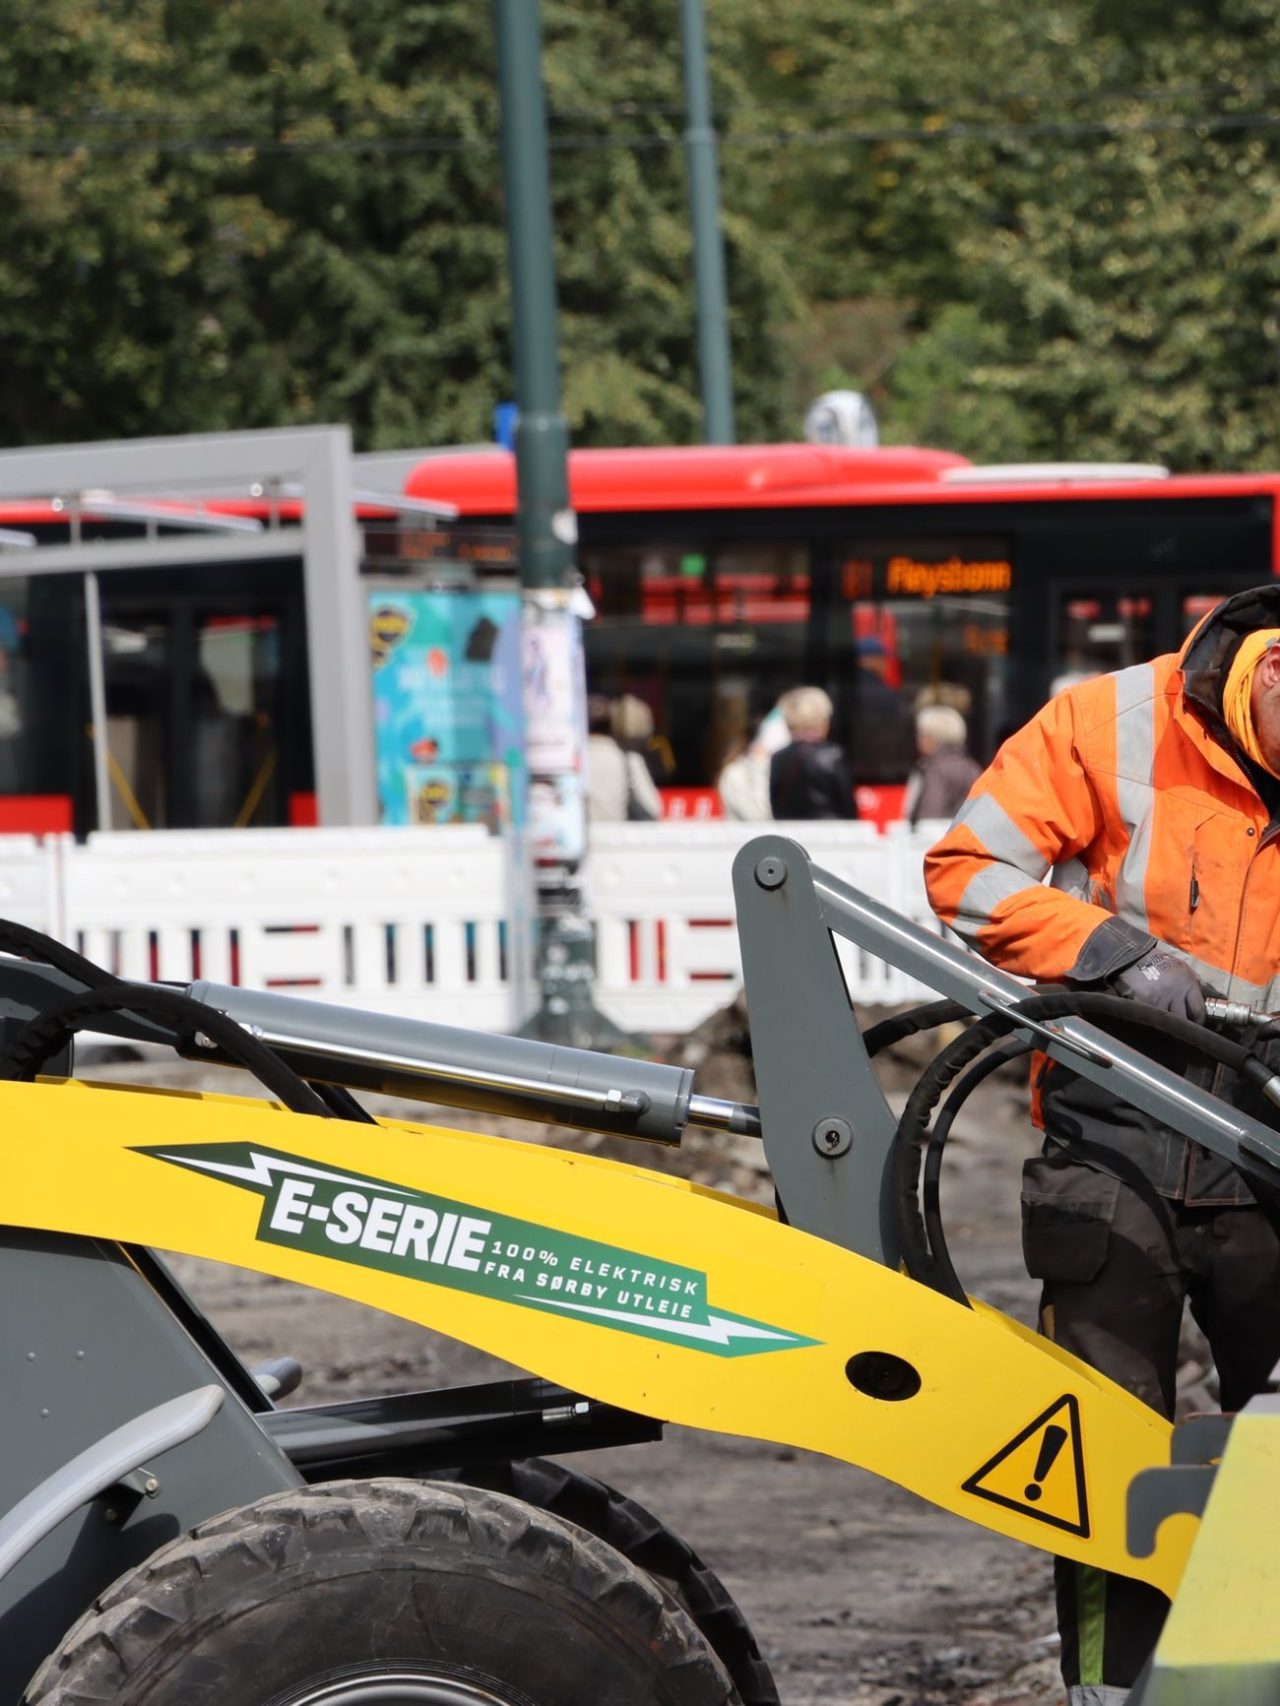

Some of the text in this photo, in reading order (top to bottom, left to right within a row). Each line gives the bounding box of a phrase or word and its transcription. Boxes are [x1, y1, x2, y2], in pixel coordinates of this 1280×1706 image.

[269, 1177, 492, 1273] E-SERIE
[483, 1261, 693, 1319] FRA SØRBY UTLEIE
[491, 1240, 699, 1296] 100% ELEKTRISK
